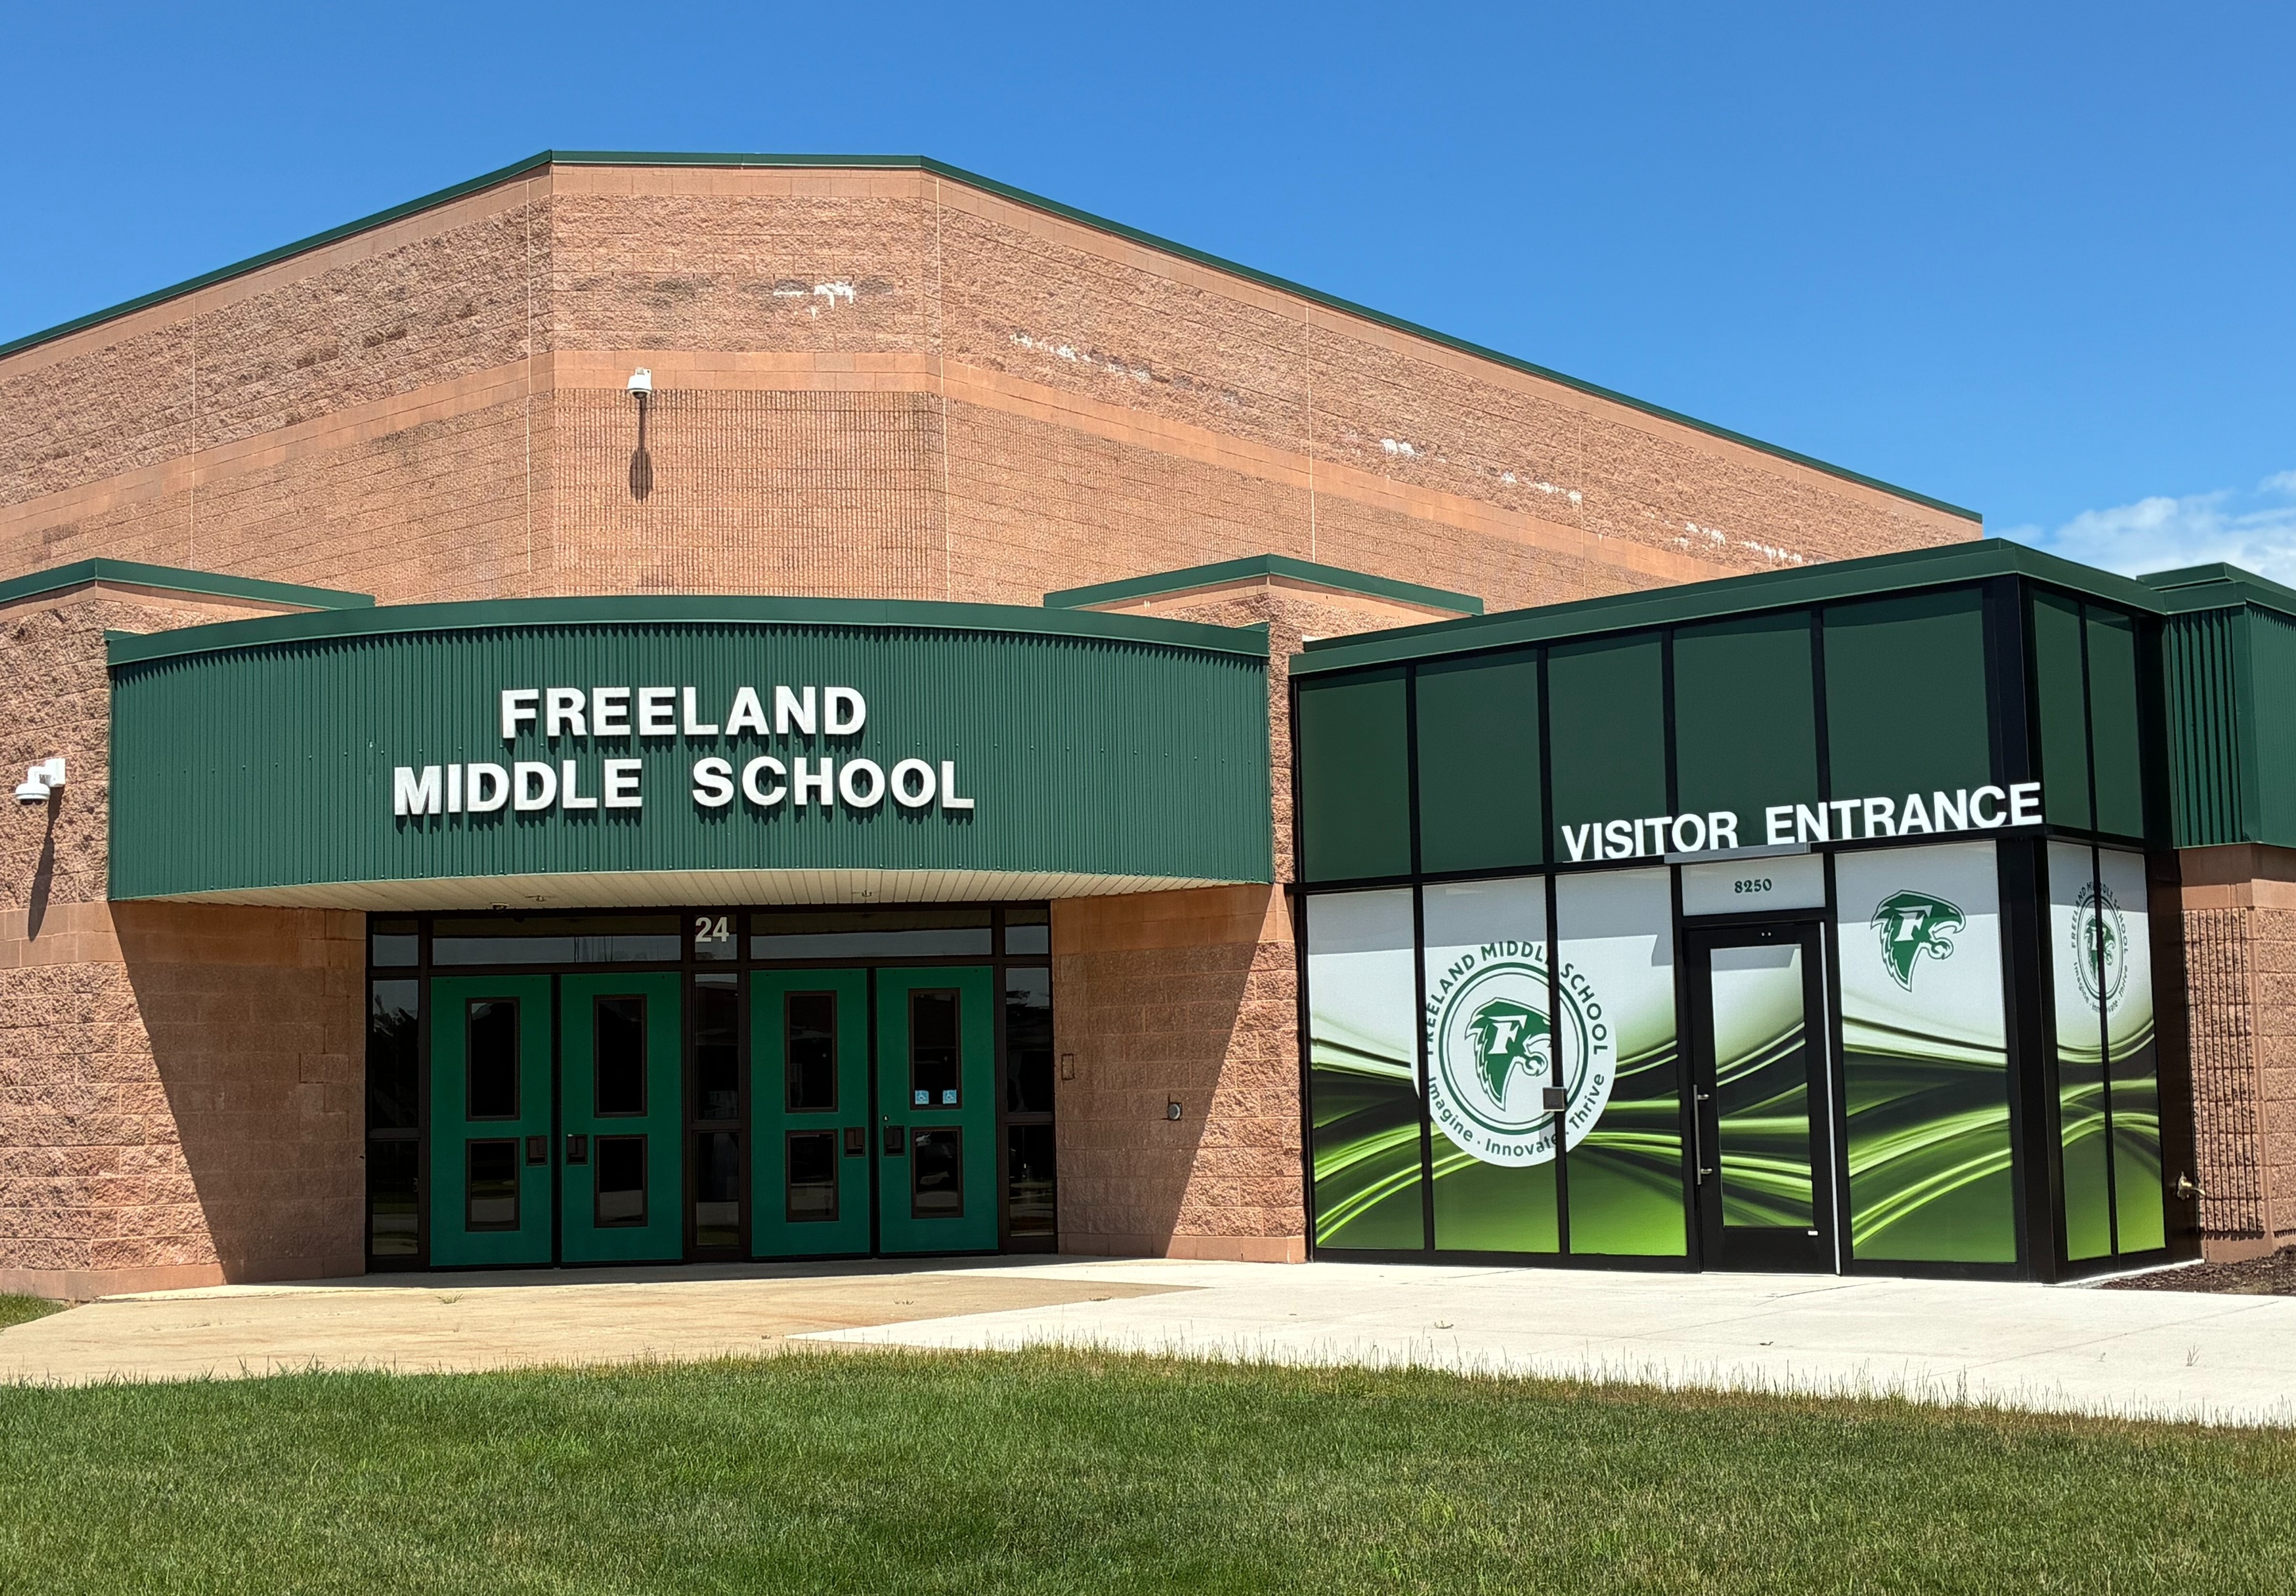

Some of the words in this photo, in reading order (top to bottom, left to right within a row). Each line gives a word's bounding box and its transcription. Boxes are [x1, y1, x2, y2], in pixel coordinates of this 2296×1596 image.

[501, 686, 866, 738] FREELAND
[394, 758, 642, 815] MIDDLE
[692, 756, 974, 808] SCHOOL
[1561, 811, 1738, 862] VISITOR
[1765, 782, 2042, 846] ENTRANCE
[1734, 878, 1772, 894] 8250
[695, 916, 729, 942] 24
[1894, 904, 1933, 942] F
[1480, 941, 1549, 965] MIDDL
[1560, 963, 1608, 1055] SCHOOL
[1487, 1014, 1527, 1054] F
[1429, 1076, 1474, 1142] Imagine
[1568, 1073, 1605, 1130] Thrive
